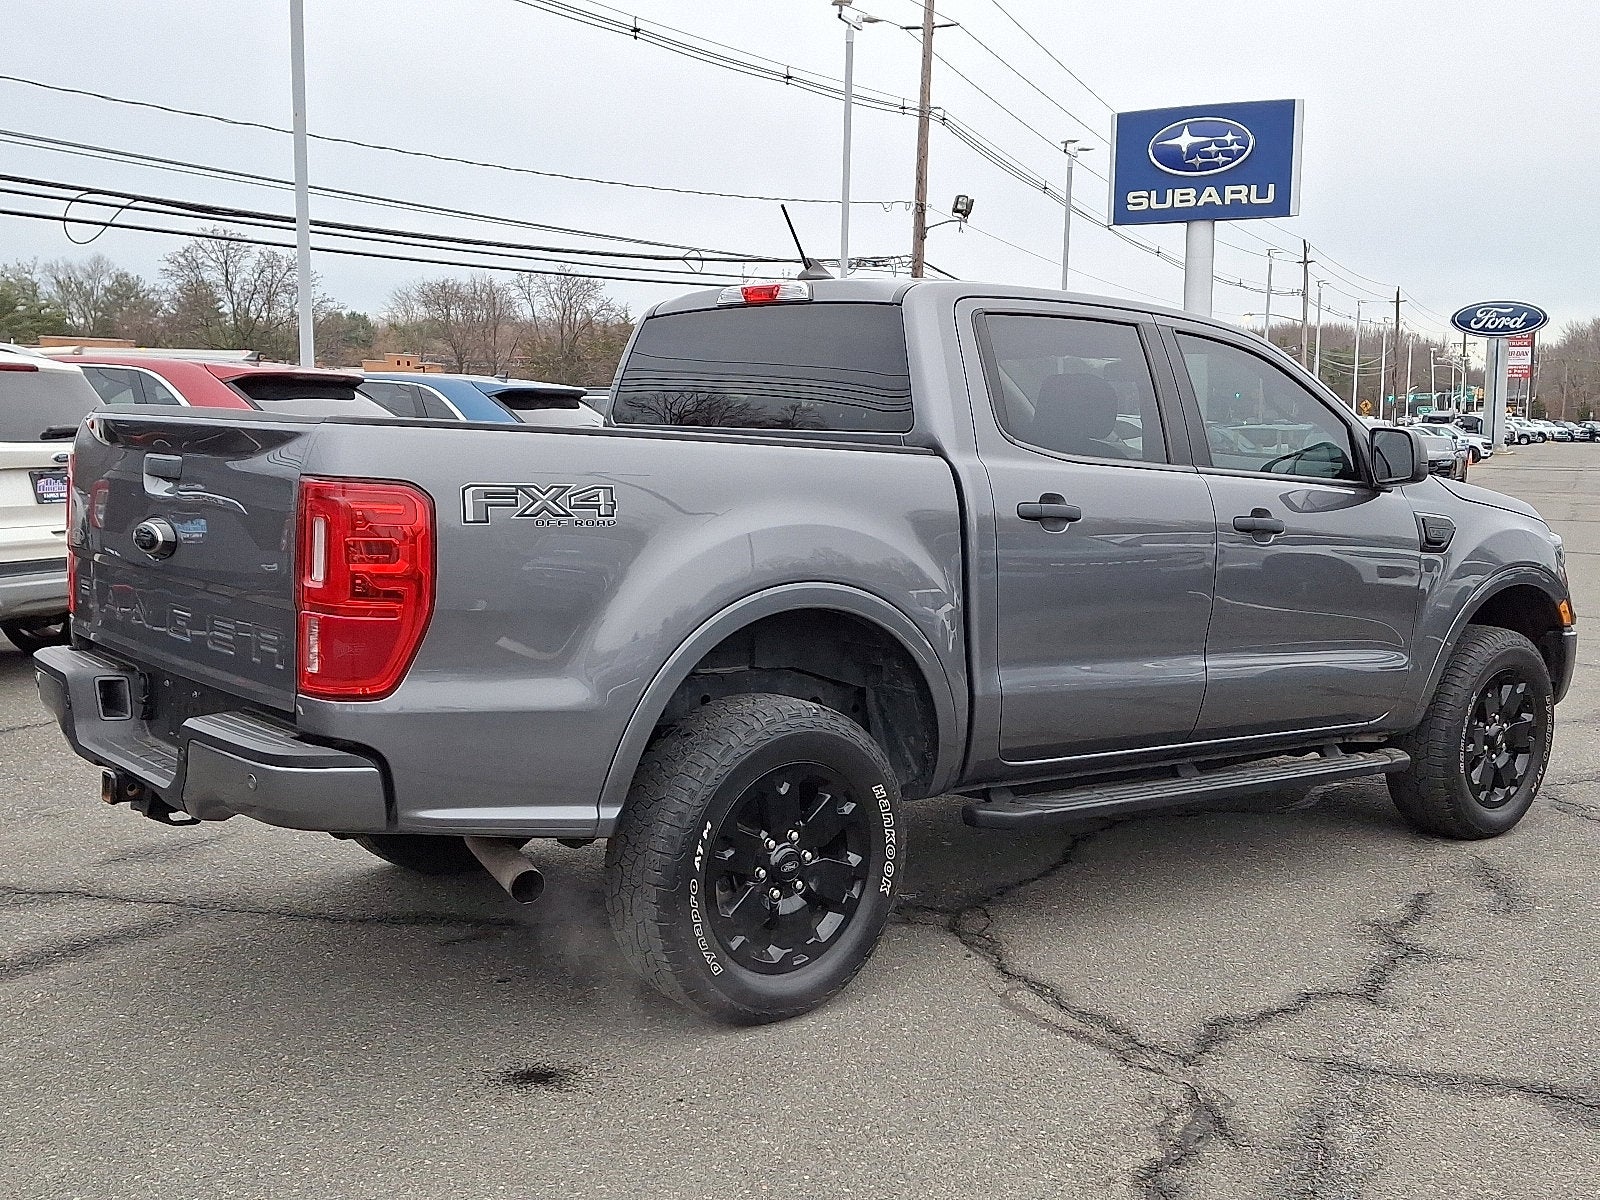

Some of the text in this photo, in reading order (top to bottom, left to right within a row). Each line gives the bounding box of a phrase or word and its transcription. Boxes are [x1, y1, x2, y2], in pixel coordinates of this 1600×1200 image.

[1126, 183, 1275, 211] SUBARU
[1470, 307, 1528, 329] Ford
[460, 482, 618, 525] FX4
[534, 518, 618, 528] OFF ROAD
